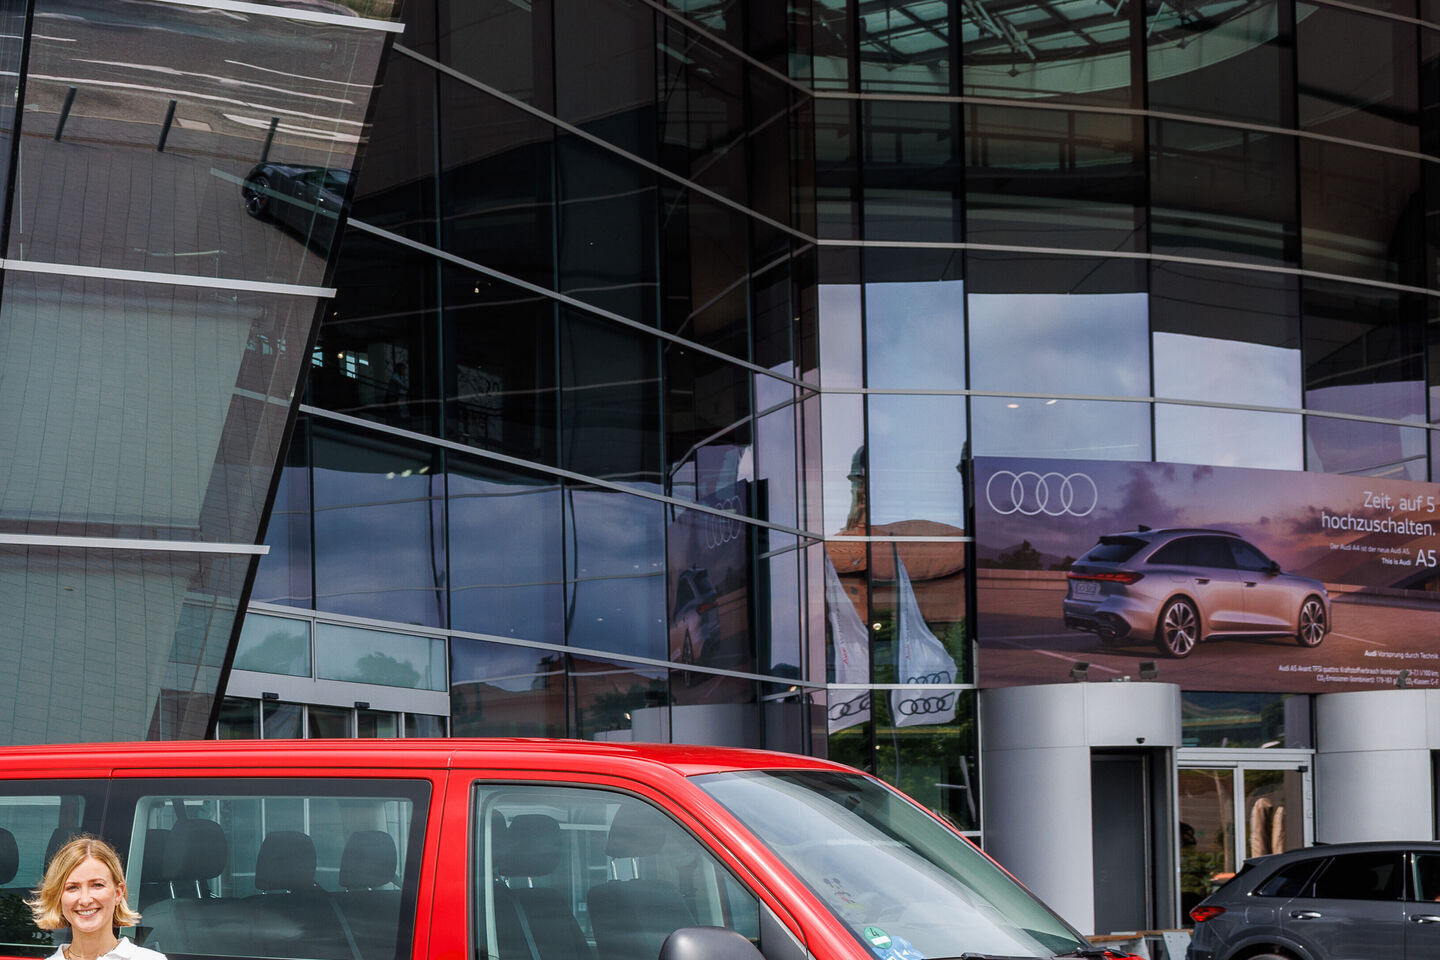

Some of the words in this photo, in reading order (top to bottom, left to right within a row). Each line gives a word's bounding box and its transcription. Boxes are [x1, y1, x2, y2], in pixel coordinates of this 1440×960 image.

[1363, 491, 1395, 512] Zeit,
[1399, 496, 1423, 512] auf
[1426, 496, 1435, 513] 5
[1321, 511, 1436, 536] hochzuschalten.
[1399, 558, 1412, 566] Audi
[1415, 549, 1437, 567] A5
